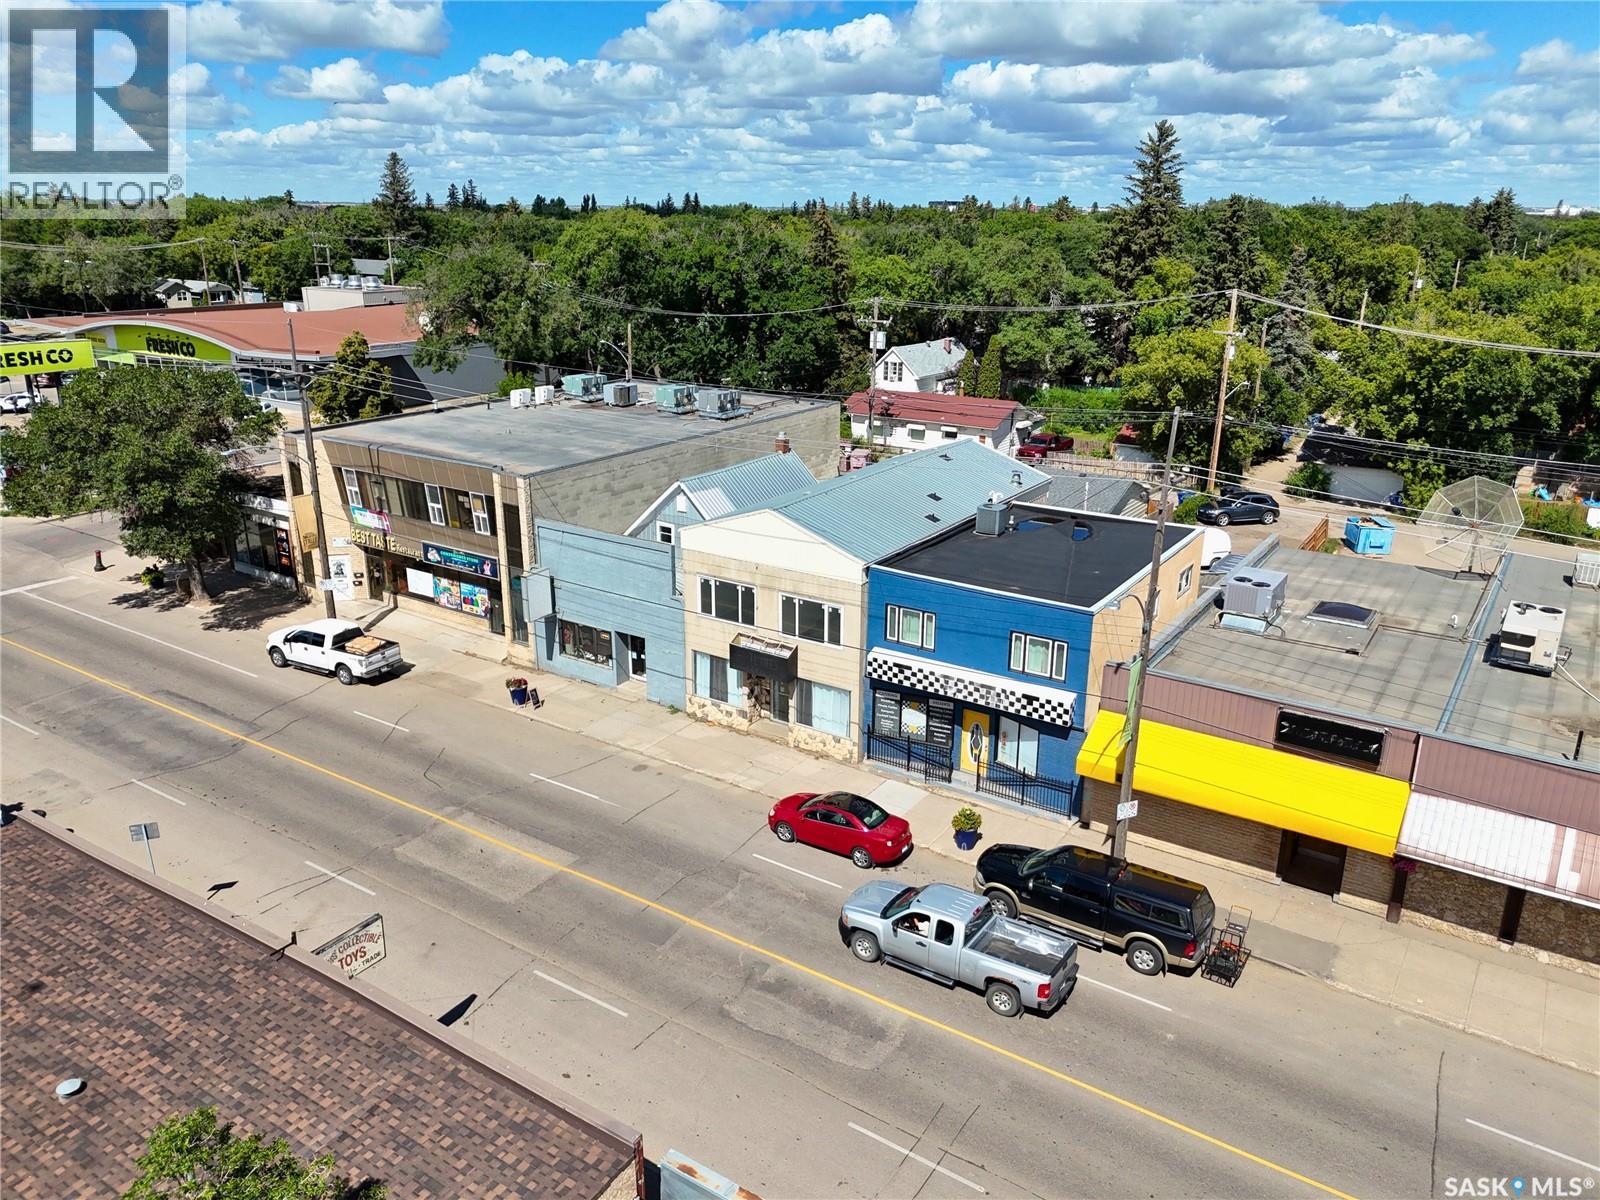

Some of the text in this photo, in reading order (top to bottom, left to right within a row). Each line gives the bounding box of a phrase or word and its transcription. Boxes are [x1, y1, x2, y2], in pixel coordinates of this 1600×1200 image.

[351, 529, 371, 545] BEST
[371, 532, 396, 552] TASTE
[338, 933, 382, 954] COLLECTIBLE
[337, 945, 367, 970] TOYS
[361, 951, 381, 966] TRADE
